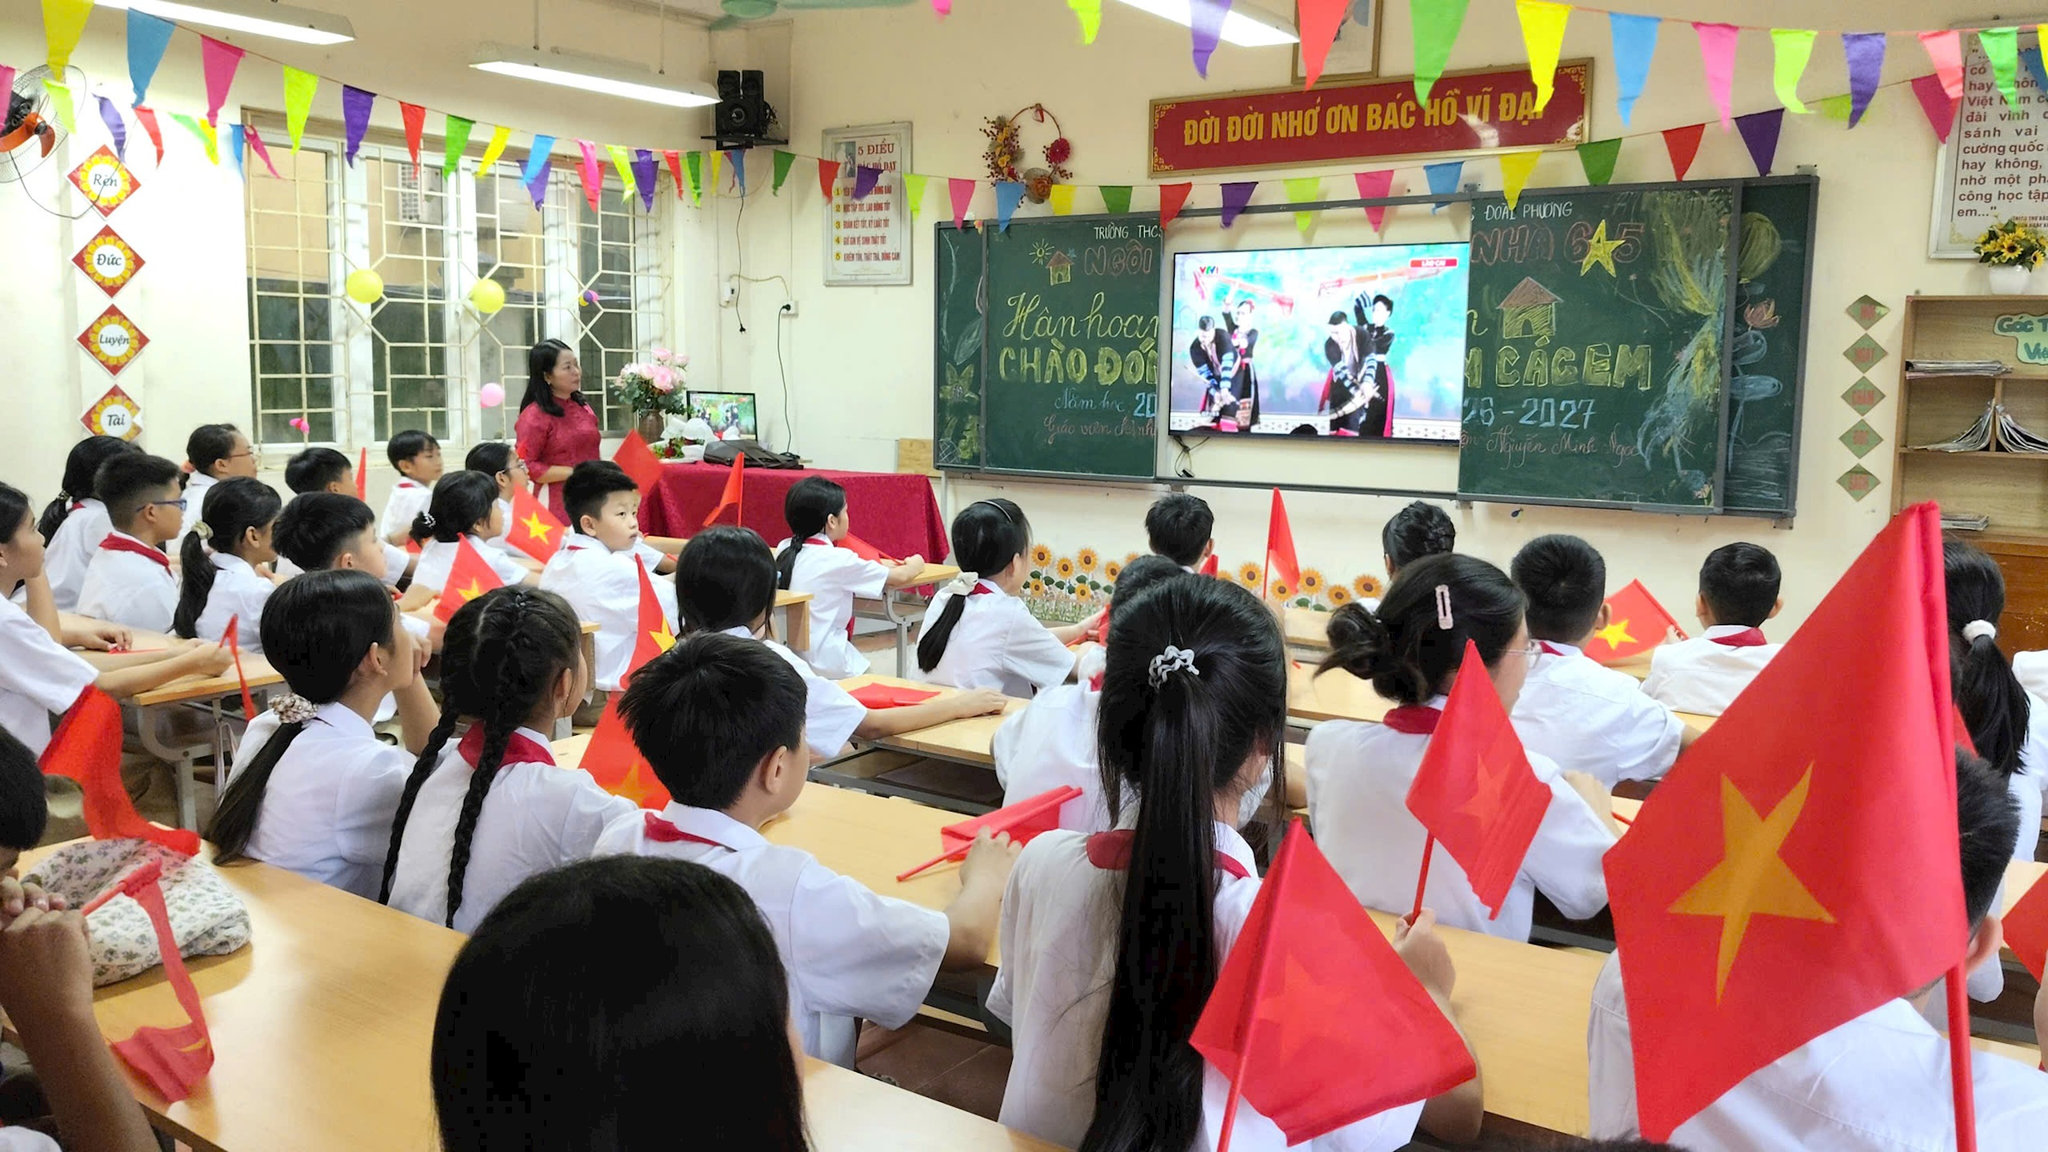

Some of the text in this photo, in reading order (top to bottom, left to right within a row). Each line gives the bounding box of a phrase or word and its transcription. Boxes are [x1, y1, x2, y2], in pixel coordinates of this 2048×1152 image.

[1969, 81, 1993, 93] hay
[1968, 95, 1993, 109] Việt
[2000, 95, 2031, 105] Nm
[1184, 110, 1220, 146] ĐỜI
[1227, 106, 1264, 142] ĐỜI
[1271, 97, 1321, 139] NHỚ
[1325, 104, 1358, 135] ƠN
[1366, 92, 1416, 131] BÁC
[1424, 88, 1460, 127] HỒ
[1466, 87, 1493, 123] VĨ
[1966, 109, 2029, 123] đài vinh
[1964, 125, 2038, 138] sánh vai
[858, 146, 864, 156] 5
[1963, 139, 2044, 156] cường quốc
[1962, 157, 2042, 172] hay không,
[1960, 175, 1986, 185] nhờ
[1994, 174, 2021, 187] một
[1958, 190, 1992, 203] công
[1998, 191, 2023, 203] học
[1523, 201, 1573, 219] PHƯƠNG
[1093, 221, 1129, 239] TRƯỜNG
[96, 253, 122, 266] Đức
[1084, 239, 1153, 277] NGÔI
[1002, 292, 1080, 341] Hân
[1998, 315, 2034, 333] Góc
[99, 334, 130, 347] Luyện
[999, 338, 1088, 384] CHÀO
[1582, 343, 1652, 392] EM
[107, 413, 125, 426] Tài
[1043, 414, 1076, 445] Giáo
[1486, 424, 1546, 470] Nguyễn
[1550, 431, 1597, 455] Minh
